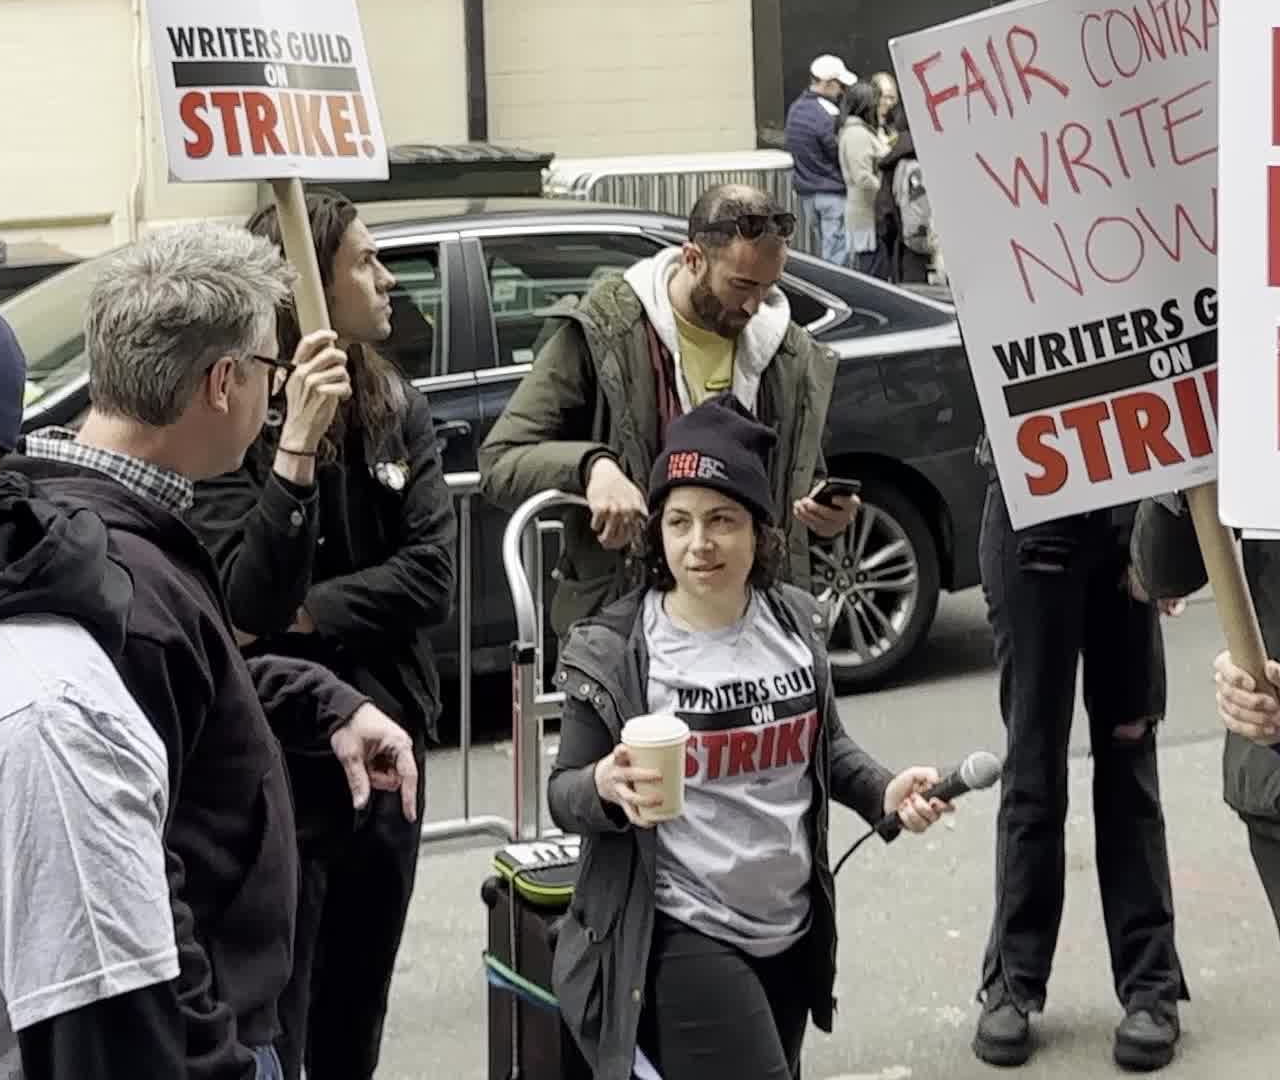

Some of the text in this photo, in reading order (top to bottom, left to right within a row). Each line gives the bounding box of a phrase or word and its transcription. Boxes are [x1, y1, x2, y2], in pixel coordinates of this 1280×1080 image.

[166, 26, 353, 64] WRITERS GUILD
[263, 63, 289, 88] ON
[912, 25, 1069, 132] FAIR
[179, 90, 376, 160] STRIKE!
[975, 80, 1218, 209] WRITE
[1010, 187, 1219, 304] NOW
[992, 299, 1184, 381] WRITERS
[1148, 342, 1194, 380] ON
[677, 664, 815, 711] WRITERS GUI
[751, 703, 775, 725] ON
